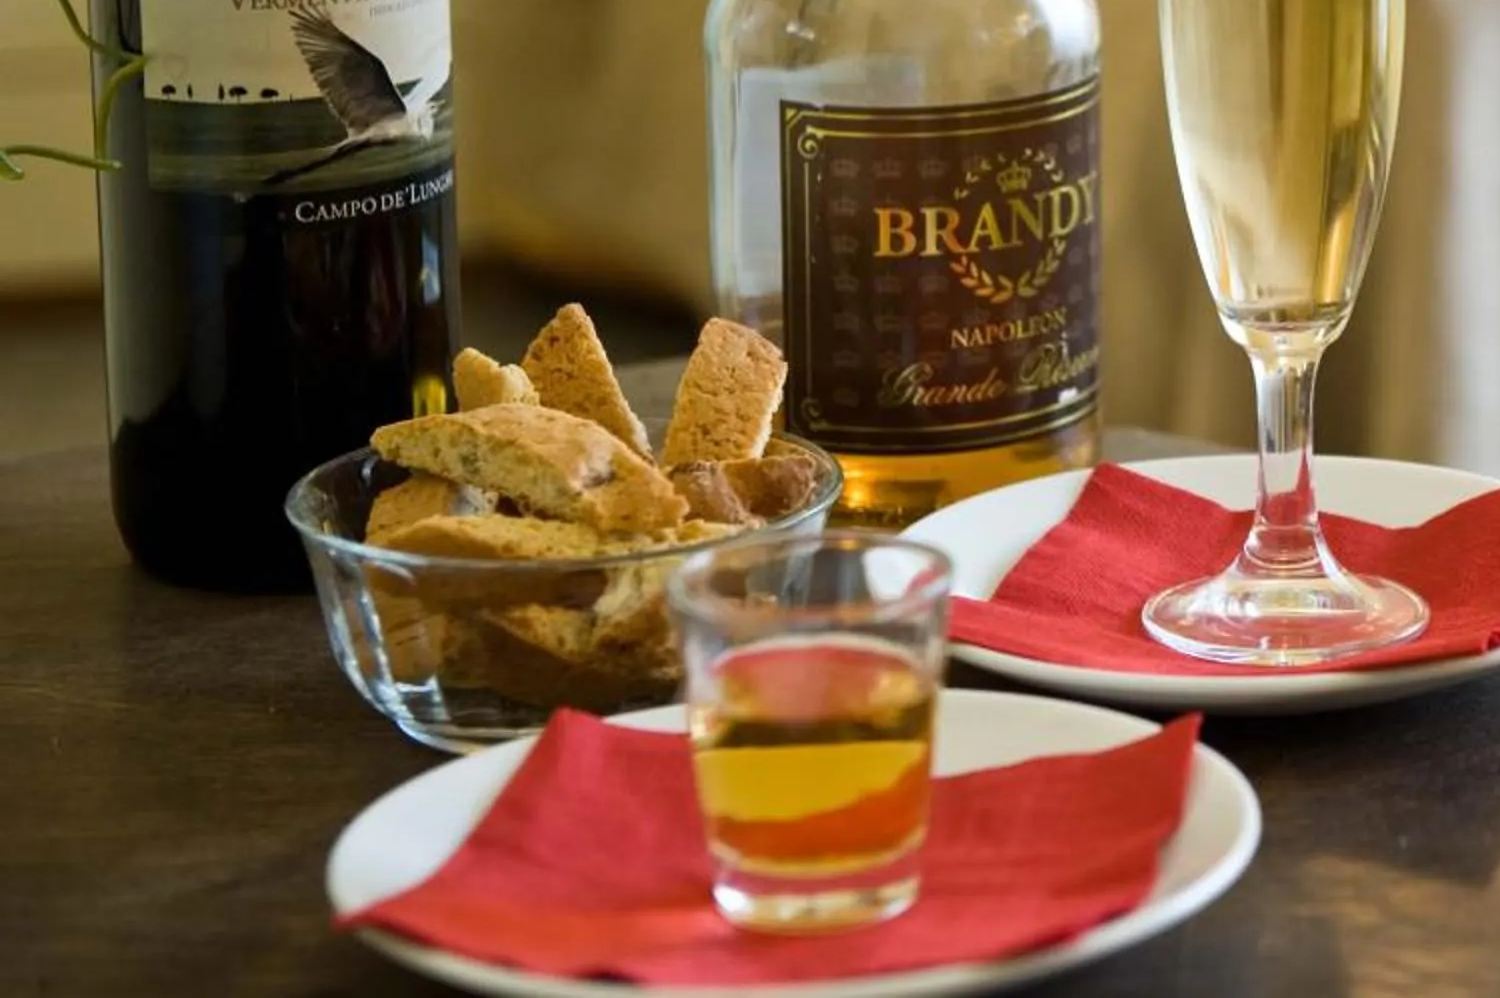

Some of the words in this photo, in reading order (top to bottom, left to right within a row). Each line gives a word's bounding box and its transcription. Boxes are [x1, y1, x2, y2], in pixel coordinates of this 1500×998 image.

[295, 196, 377, 223] CAMPO
[873, 170, 1098, 257] BRANDY
[950, 306, 1068, 349] NAPOLEON
